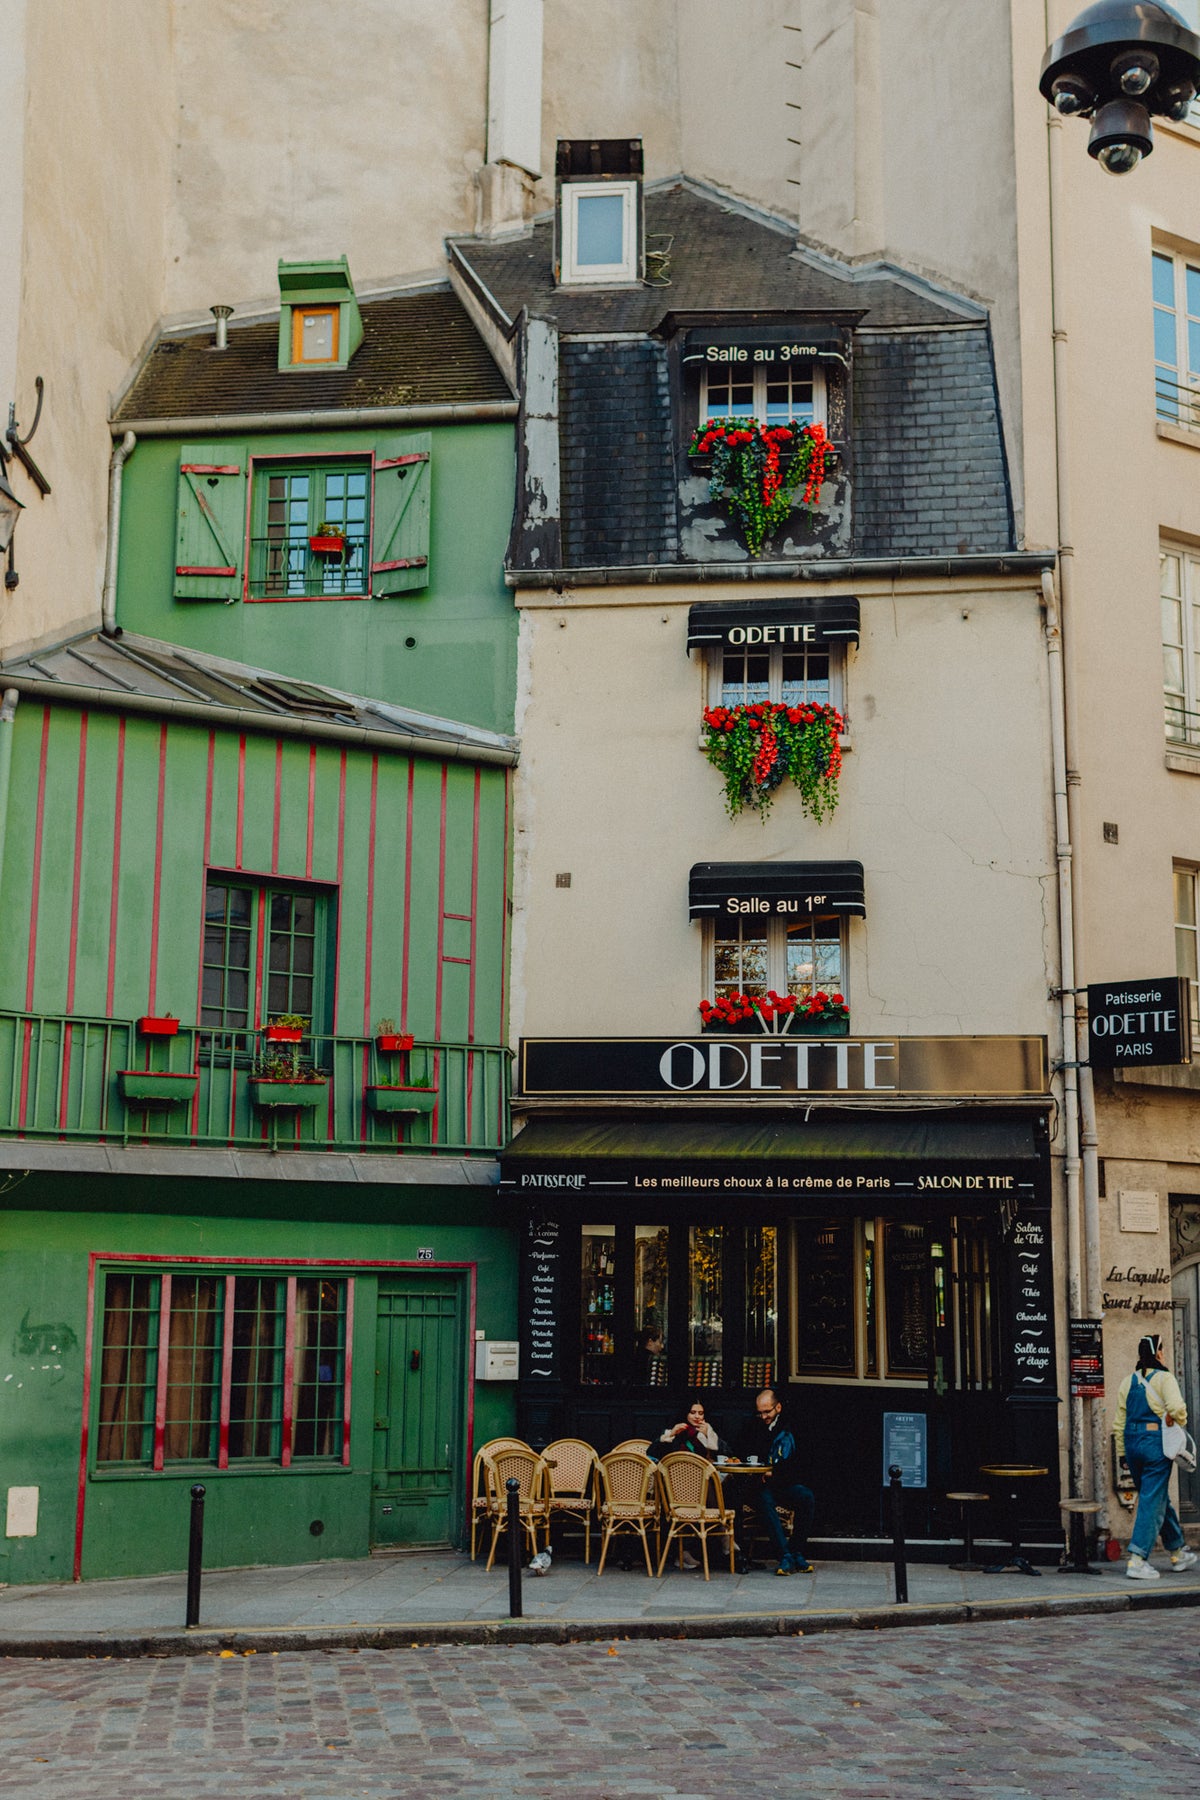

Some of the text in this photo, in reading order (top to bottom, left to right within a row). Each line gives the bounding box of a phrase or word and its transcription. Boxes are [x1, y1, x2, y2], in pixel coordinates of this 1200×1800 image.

[706, 346, 748, 362] Salle
[753, 349, 775, 361] au
[728, 624, 816, 645] ODETTE
[726, 895, 827, 913] Salle au 1er
[1105, 990, 1162, 1006] Patisserie
[1092, 1010, 1177, 1037] ODETTE
[1115, 1042, 1153, 1057] PARIS
[659, 1042, 896, 1091] ODETTE
[521, 1174, 587, 1190] PATISSERIE
[634, 1175, 658, 1188] Les
[661, 1175, 720, 1188] meilleurs
[723, 1175, 762, 1188] choux
[765, 1175, 774, 1188] à
[777, 1175, 789, 1188] la
[836, 1175, 853, 1188] de
[856, 1175, 891, 1188] Paris
[917, 1175, 1014, 1190] SALON DE THE
[1015, 1222, 1042, 1233] Salon
[1013, 1233, 1045, 1244] de Thé
[419, 1250, 432, 1259] 75
[537, 1264, 550, 1273] Café
[1021, 1263, 1039, 1276] Café
[1106, 1266, 1123, 1283] La
[1021, 1287, 1041, 1297] Thés
[534, 1296, 552, 1305] Citron
[1101, 1293, 1177, 1315] Saint Jacques
[1015, 1311, 1048, 1322] Chocolat
[1014, 1342, 1051, 1354] Salle au
[530, 1351, 554, 1360] Caramel
[1026, 1355, 1050, 1369] étage
